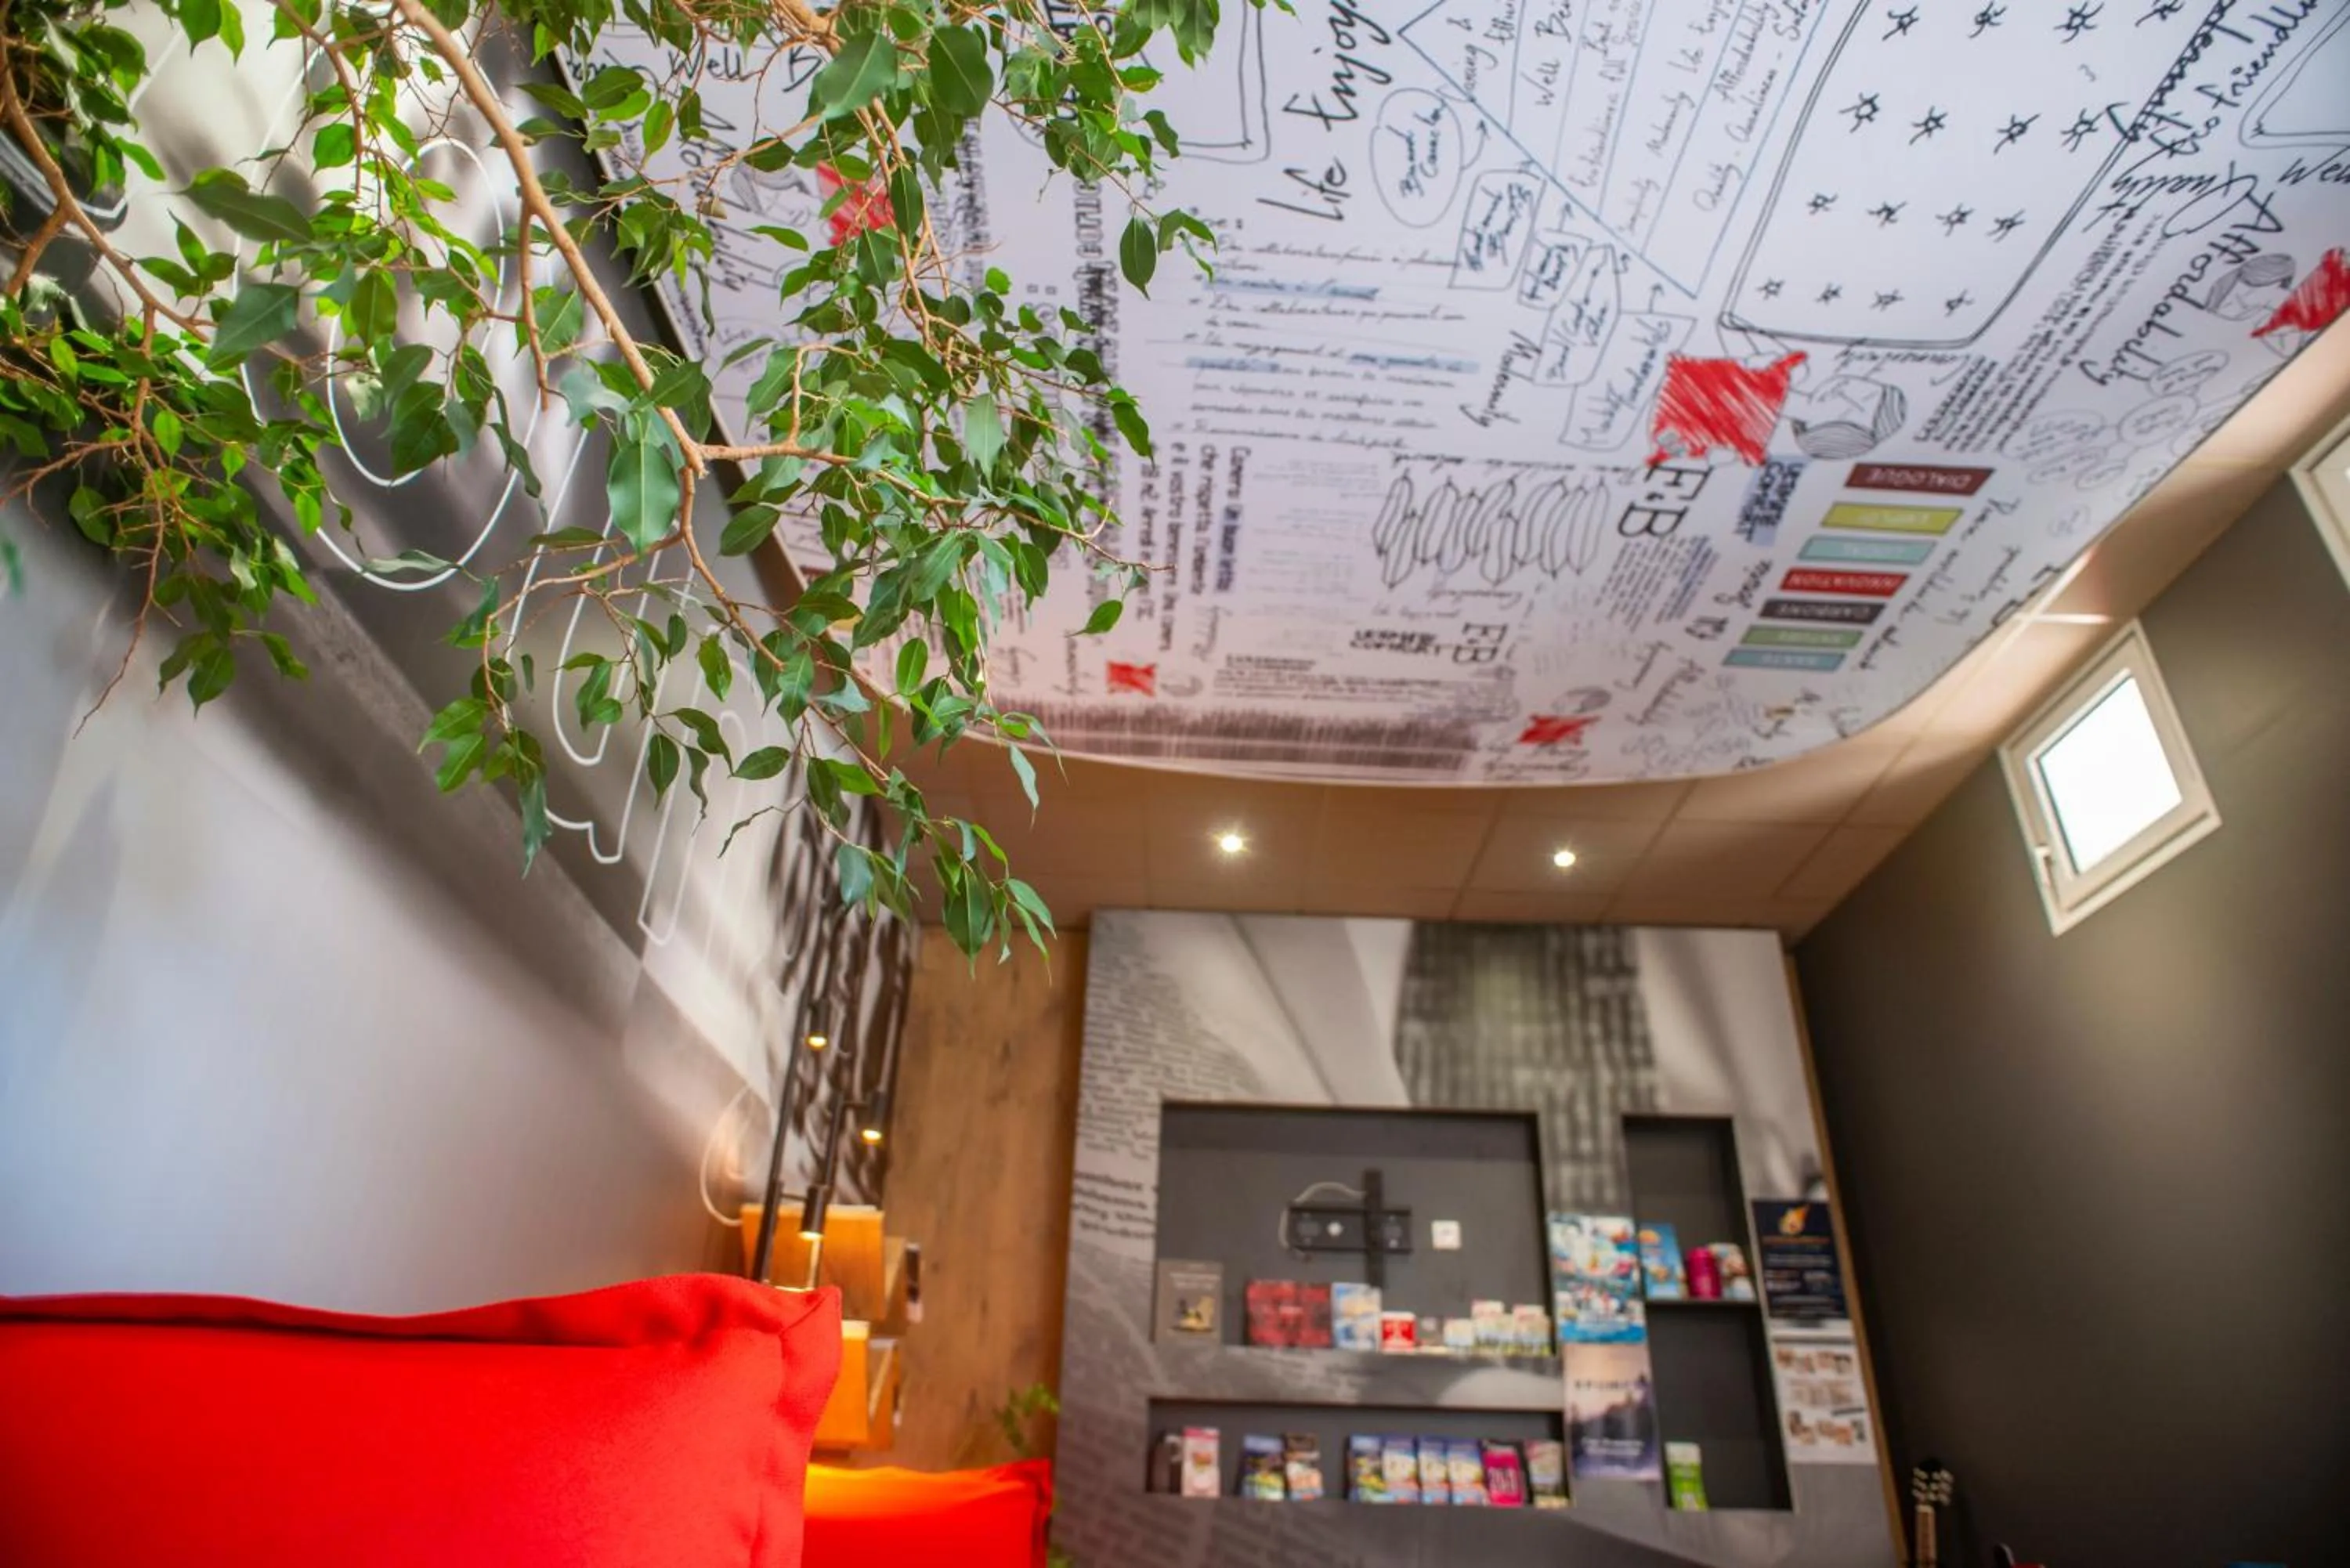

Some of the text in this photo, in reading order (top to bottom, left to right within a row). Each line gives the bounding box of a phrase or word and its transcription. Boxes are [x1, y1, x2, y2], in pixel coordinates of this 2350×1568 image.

[668, 39, 742, 80] Well
[1520, 56, 1560, 107] Well
[1256, 0, 1394, 221] Life Enjoy
[2079, 191, 2283, 386] Affordability
[1459, 329, 1542, 428] Modernity
[1867, 468, 1972, 490] DIALOGUE
[1788, 573, 1899, 593] INNOVATION
